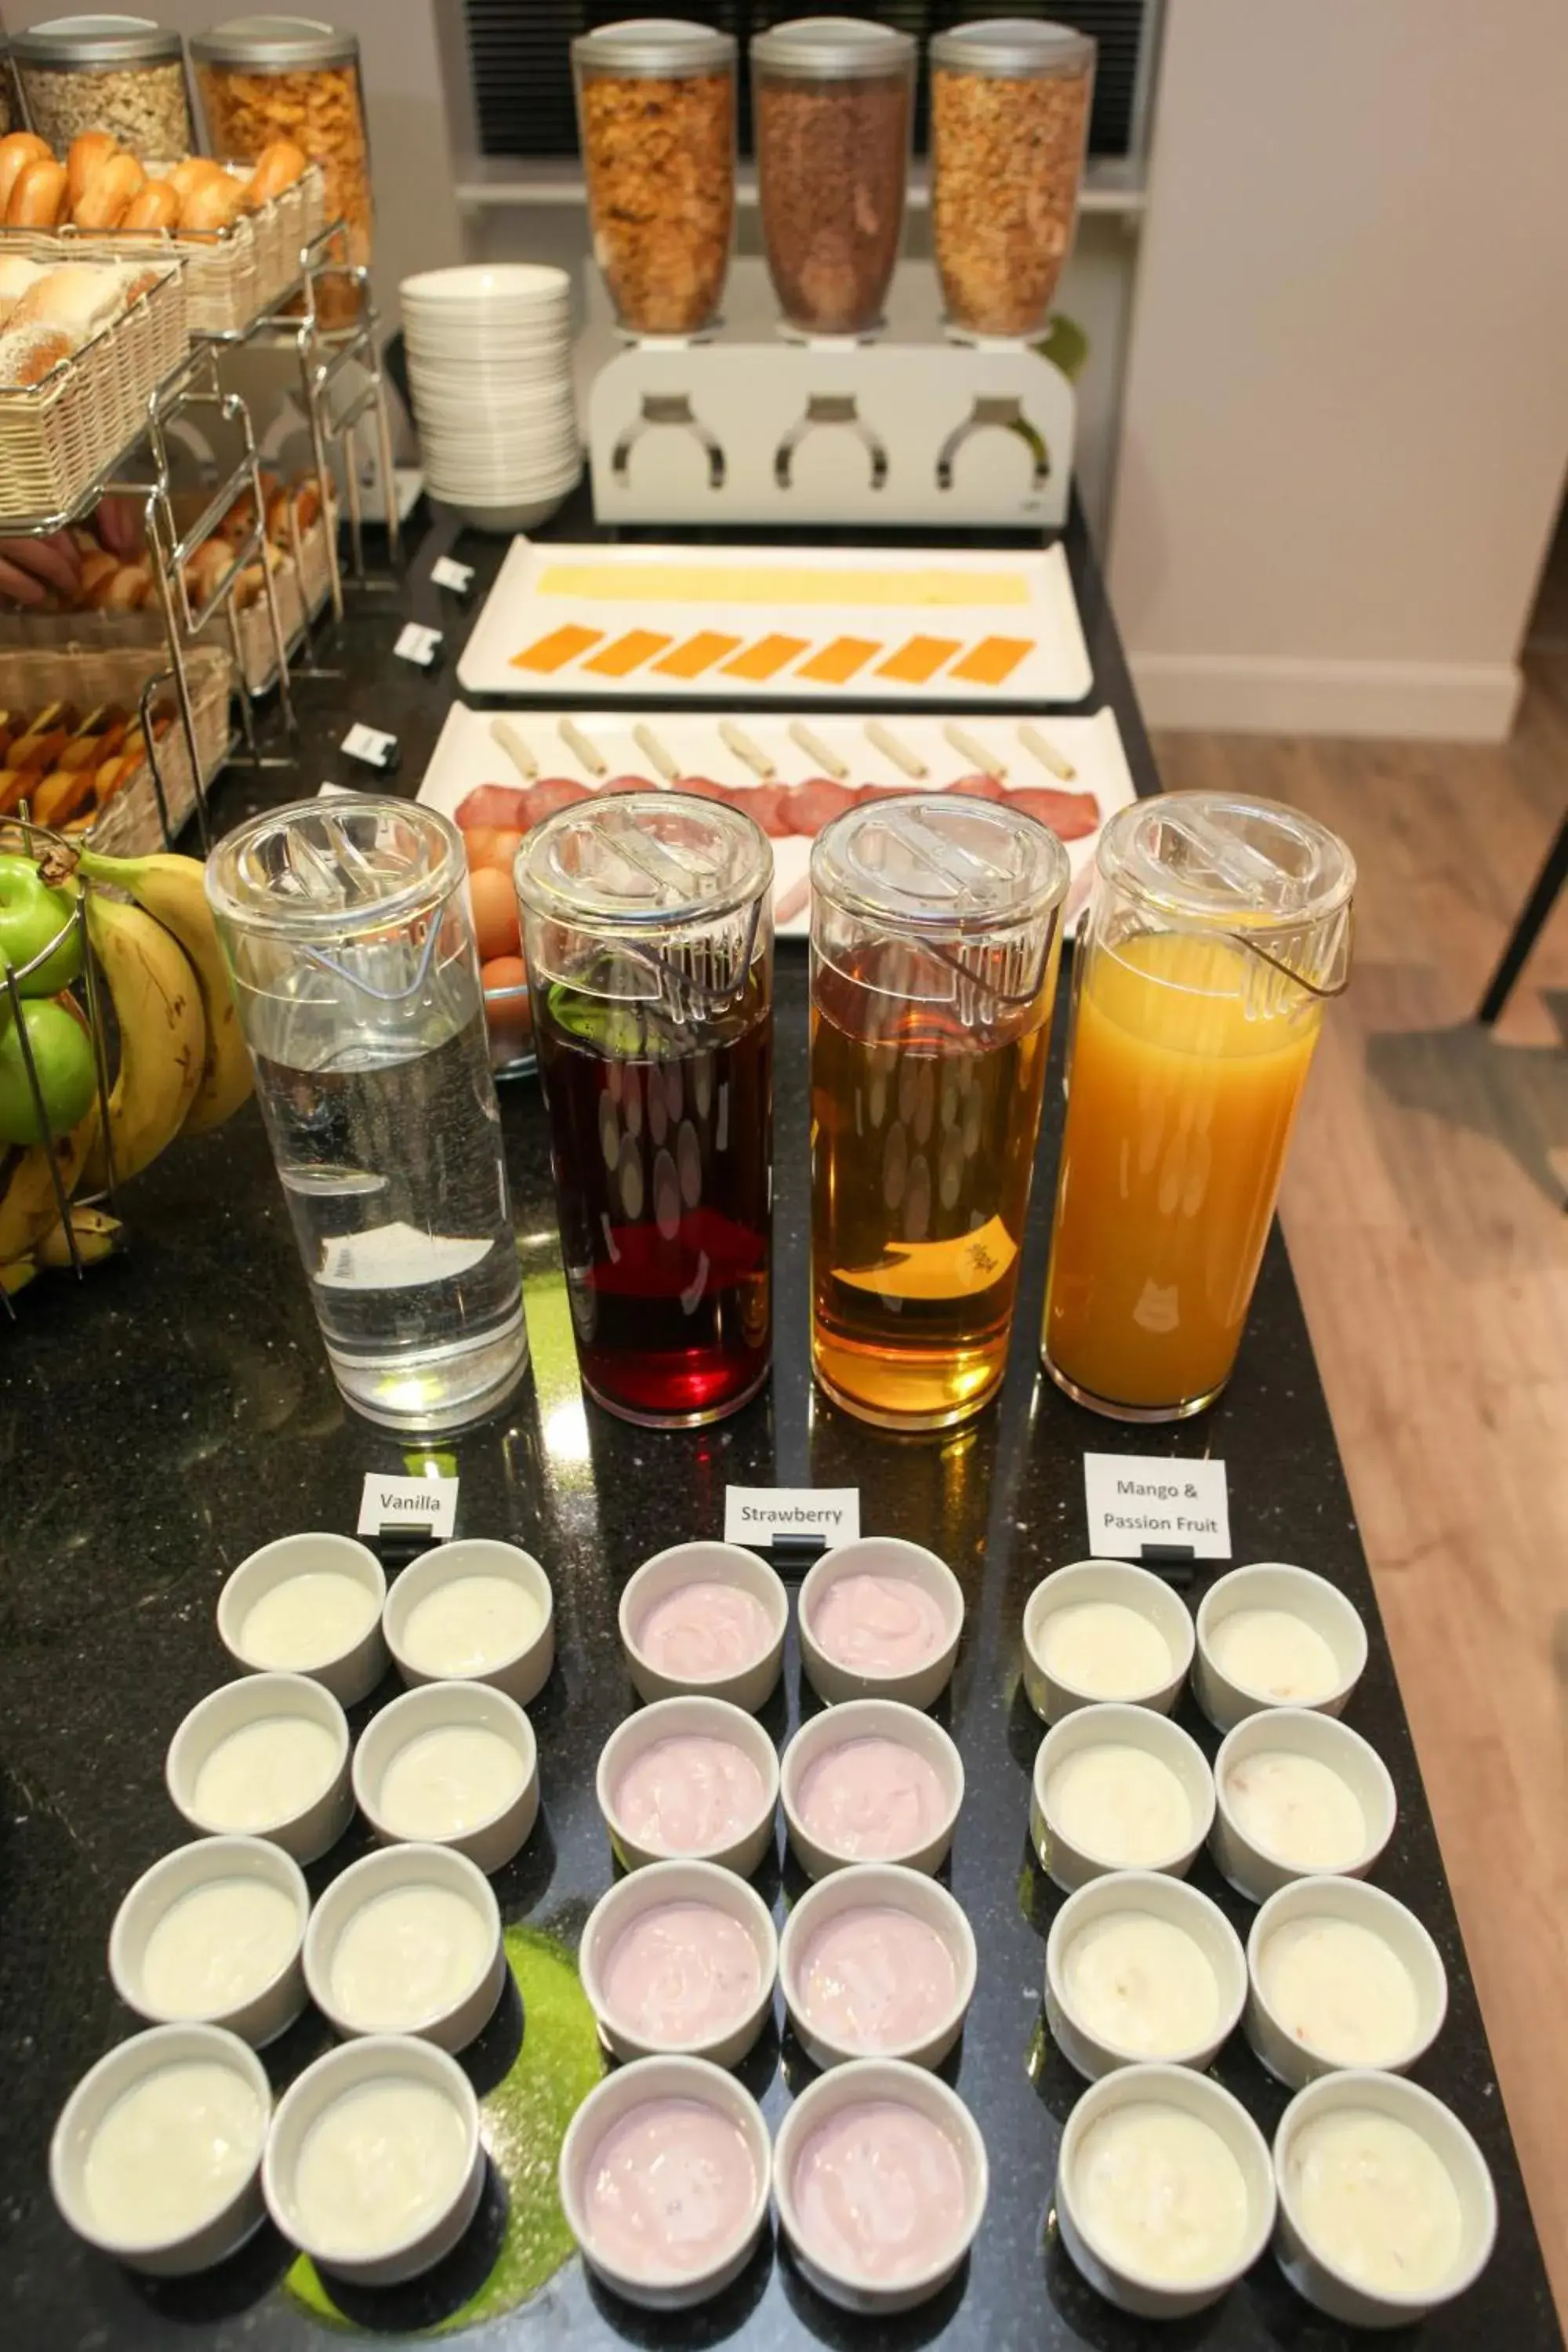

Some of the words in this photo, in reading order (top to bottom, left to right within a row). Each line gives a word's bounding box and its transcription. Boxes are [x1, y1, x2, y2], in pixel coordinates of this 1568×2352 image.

[1116, 1479, 1178, 1500] Mango
[1184, 1483, 1198, 1499] &
[380, 1494, 441, 1512] Vanilla
[741, 1505, 843, 1526] Strawberry
[1104, 1513, 1171, 1531] Passion
[1177, 1517, 1218, 1534] Fruit
